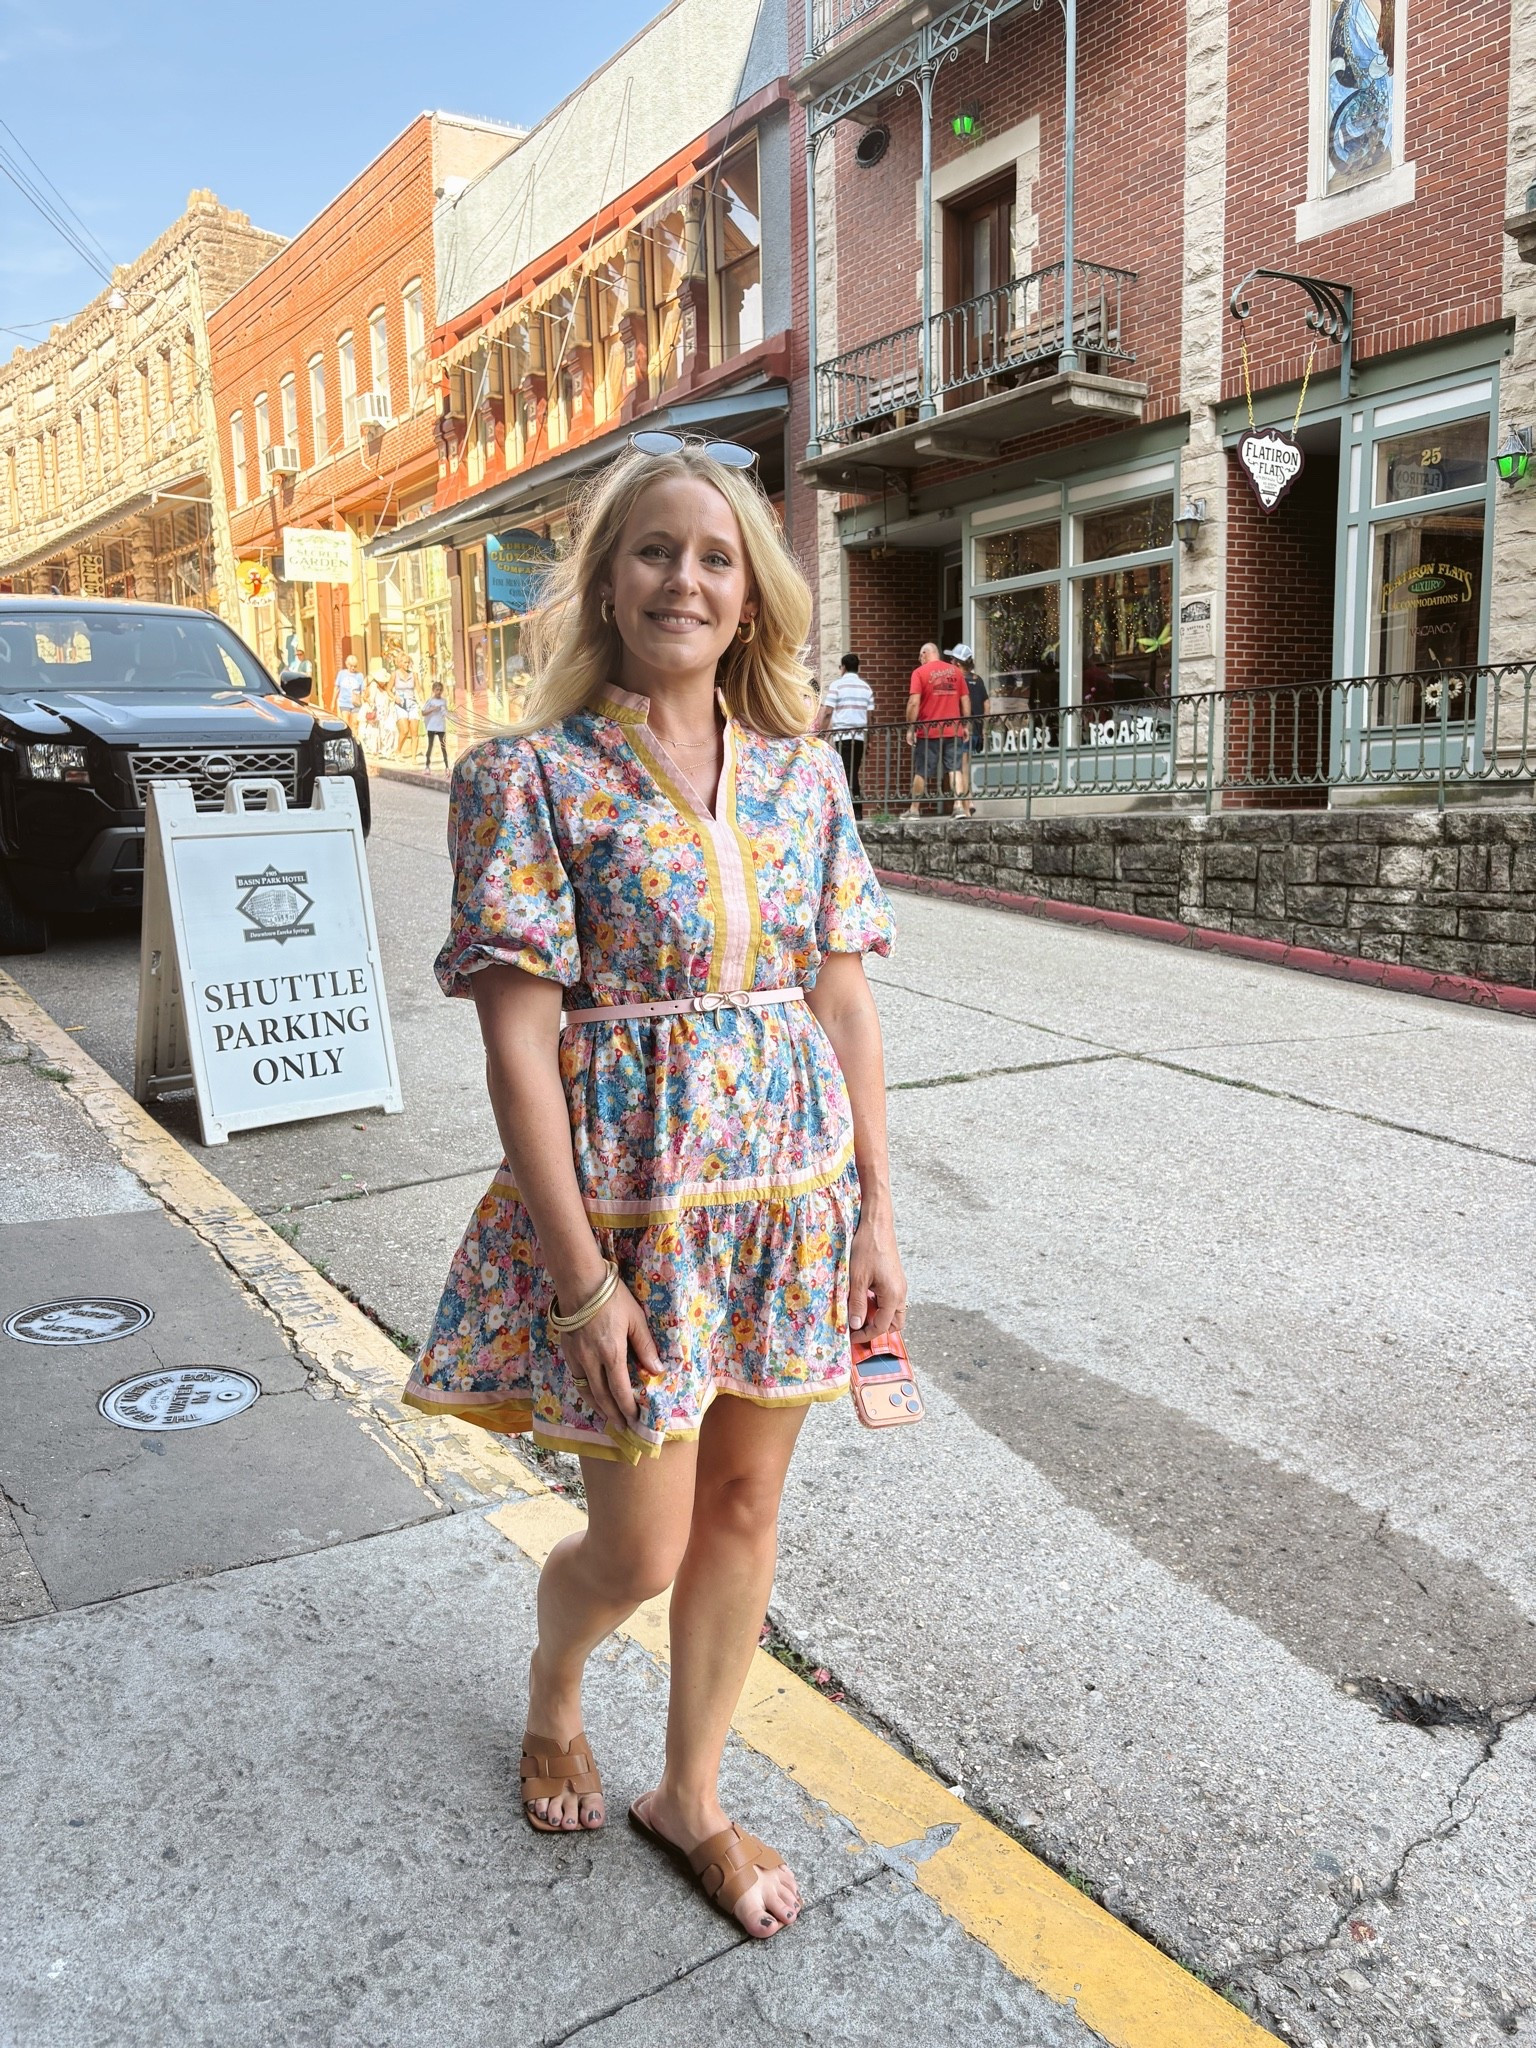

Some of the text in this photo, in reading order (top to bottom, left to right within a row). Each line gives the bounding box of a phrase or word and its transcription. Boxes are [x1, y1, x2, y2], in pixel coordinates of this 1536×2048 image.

[1246, 441, 1299, 467] FLATIRON
[1421, 447, 1442, 466] 25
[1259, 462, 1286, 485] FLATS
[289, 557, 349, 567] GARDEN
[82, 556, 98, 594] NELS
[1411, 580, 1442, 592] LUXURY
[1381, 563, 1472, 613] FLATIRON FLATS
[1391, 594, 1459, 610] ACCOMMODATIONS
[1410, 622, 1457, 637] VACANCY
[238, 875, 306, 887] BASIN PARK HOTEL
[250, 927, 310, 938] Downtown Eureka Springs
[204, 968, 368, 1013] SHUTTLE
[212, 1006, 370, 1052] PARKING
[253, 1048, 345, 1086] ONLY
[166, 1384, 195, 1414] WATER
